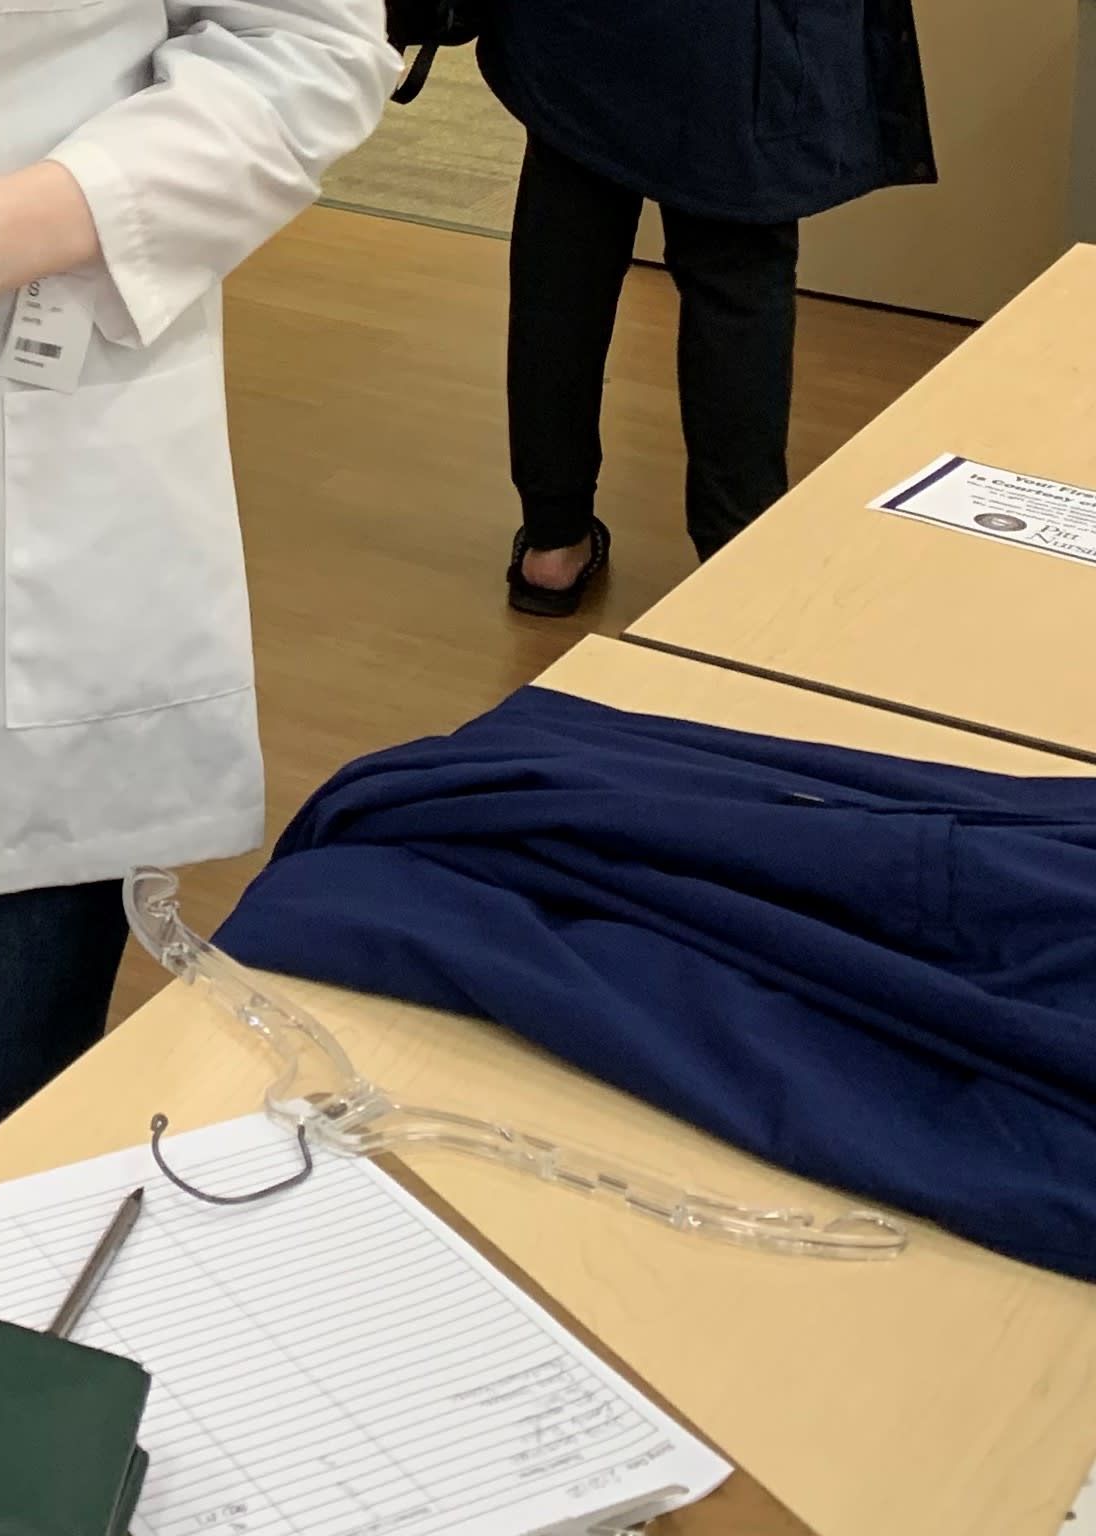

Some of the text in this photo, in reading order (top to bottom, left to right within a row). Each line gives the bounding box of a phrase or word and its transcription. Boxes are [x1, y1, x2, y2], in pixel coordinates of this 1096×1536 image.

[1015, 476, 1096, 500] Your Firs
[1024, 532, 1096, 557] Nursi
[1040, 524, 1080, 541] Pitt
